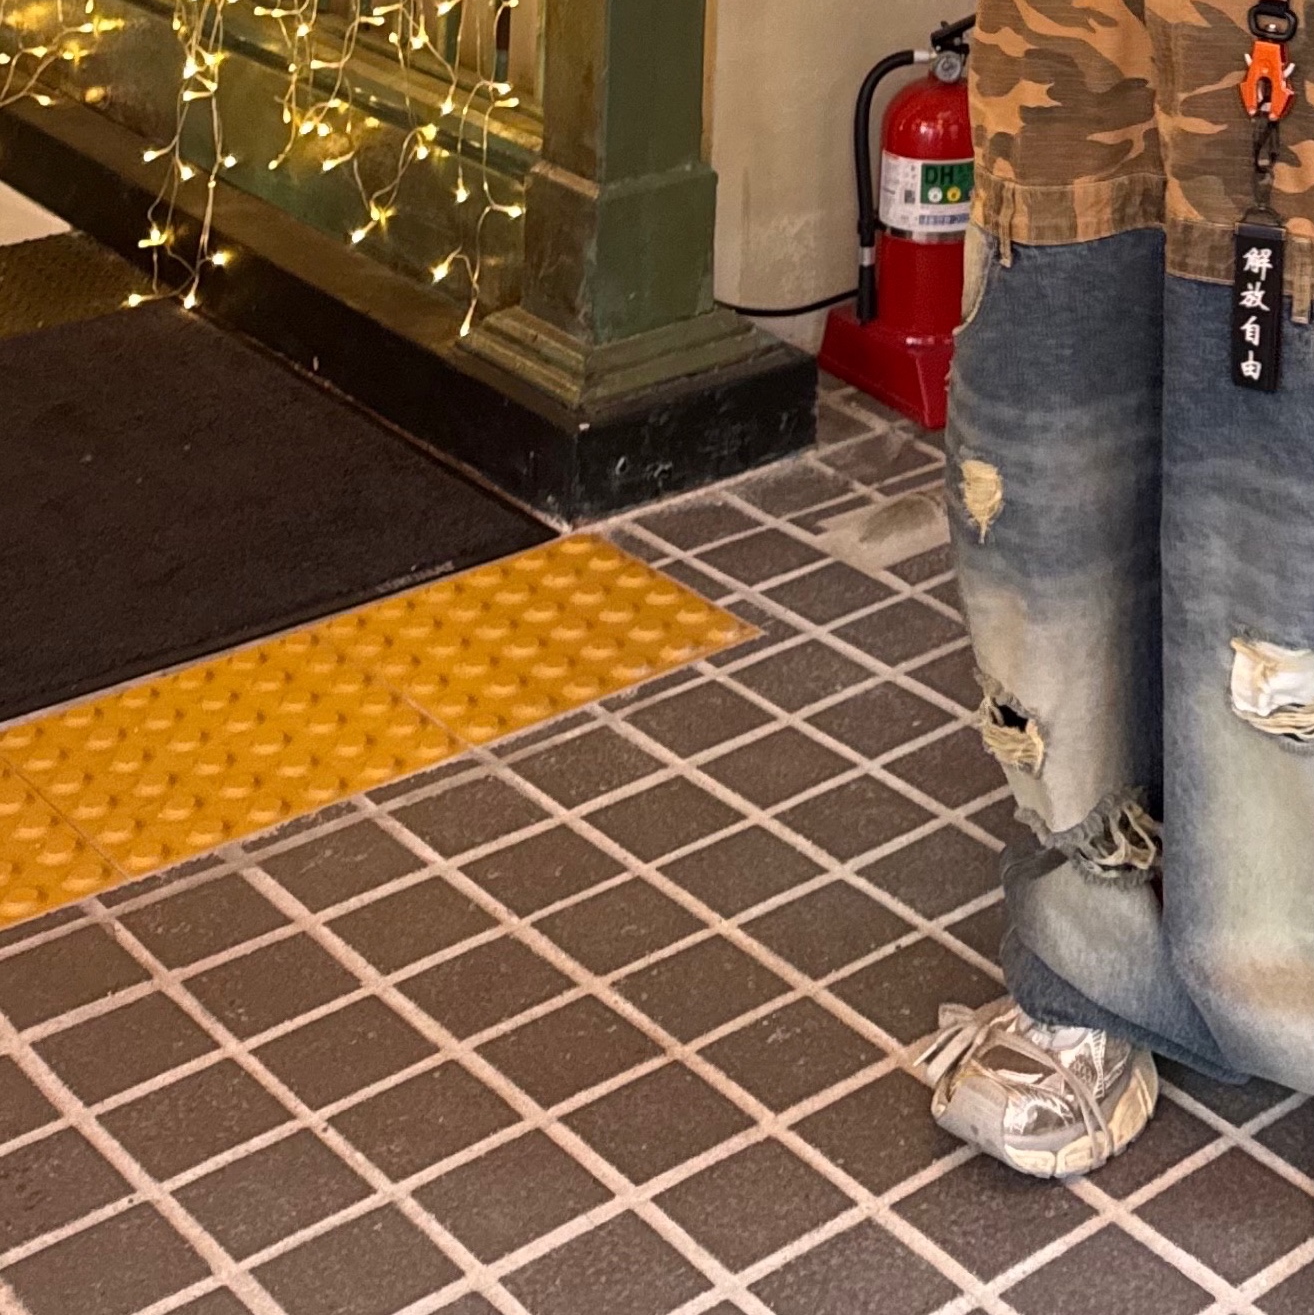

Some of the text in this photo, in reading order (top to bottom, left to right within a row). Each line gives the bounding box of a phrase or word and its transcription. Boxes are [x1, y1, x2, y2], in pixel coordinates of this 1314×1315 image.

[925, 166, 954, 184] DH
[1239, 246, 1273, 380] 解放自由
